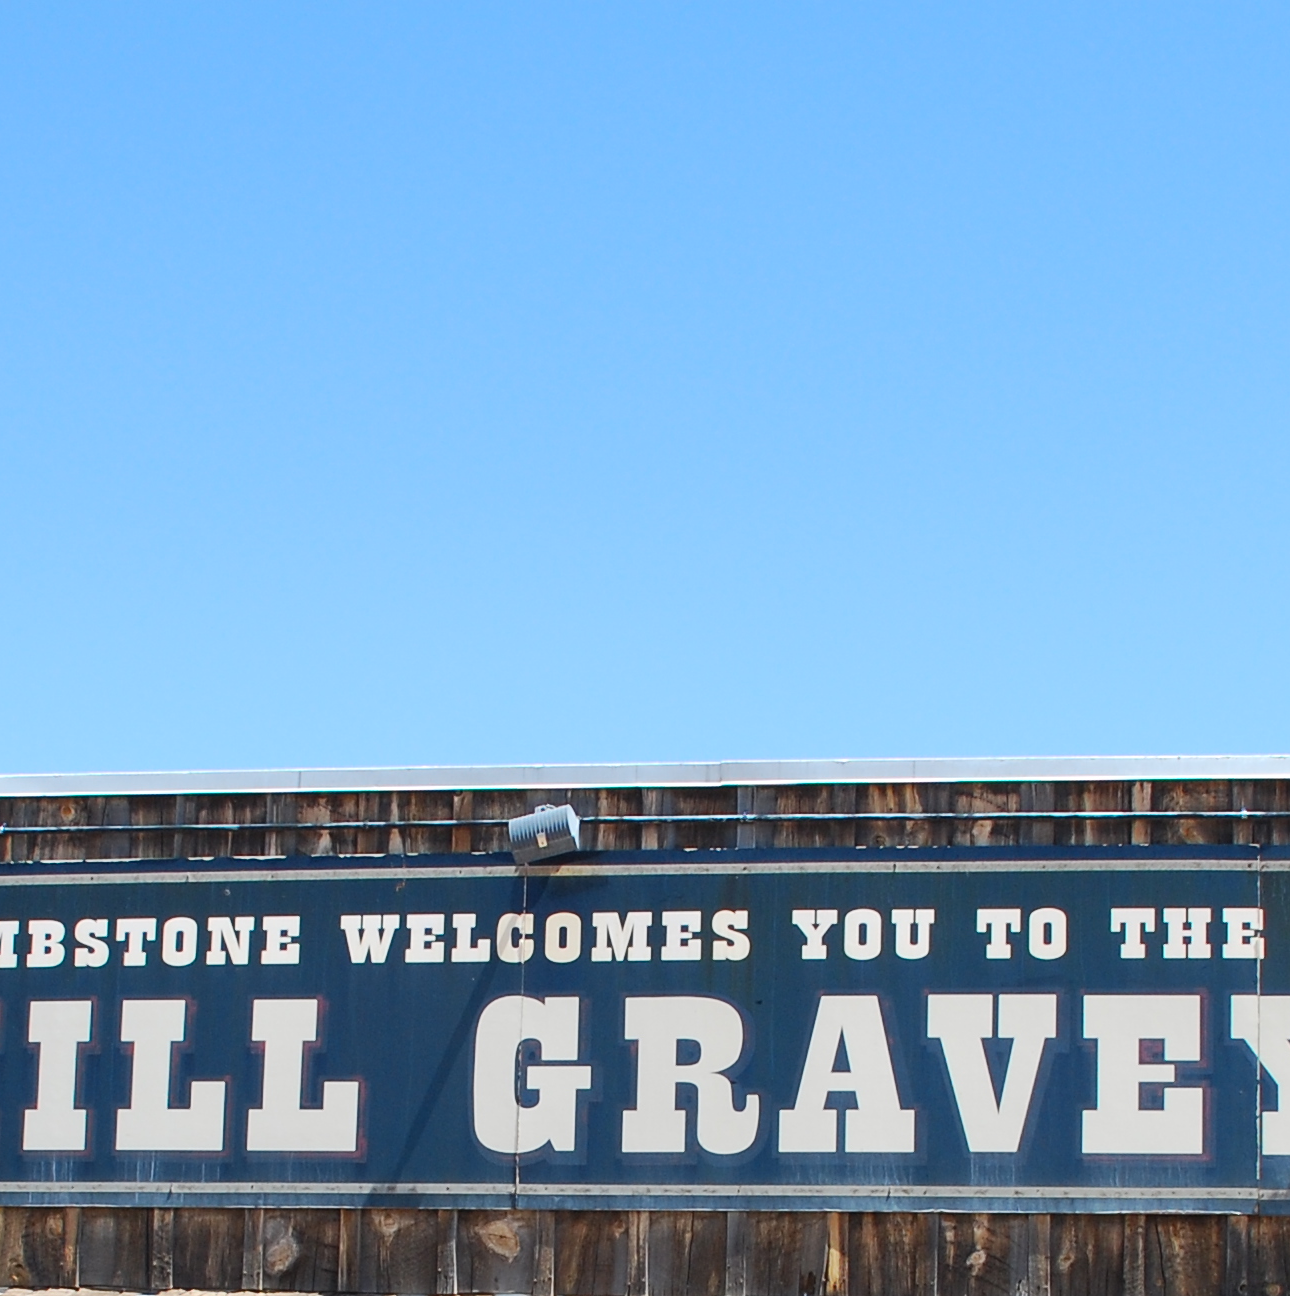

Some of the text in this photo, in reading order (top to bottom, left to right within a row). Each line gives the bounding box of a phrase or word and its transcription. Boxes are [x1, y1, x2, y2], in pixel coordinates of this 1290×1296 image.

[340, 910, 751, 964] WELCOMES
[791, 908, 935, 961] YOU
[976, 907, 1067, 960] TO
[1110, 907, 1265, 960] THE
